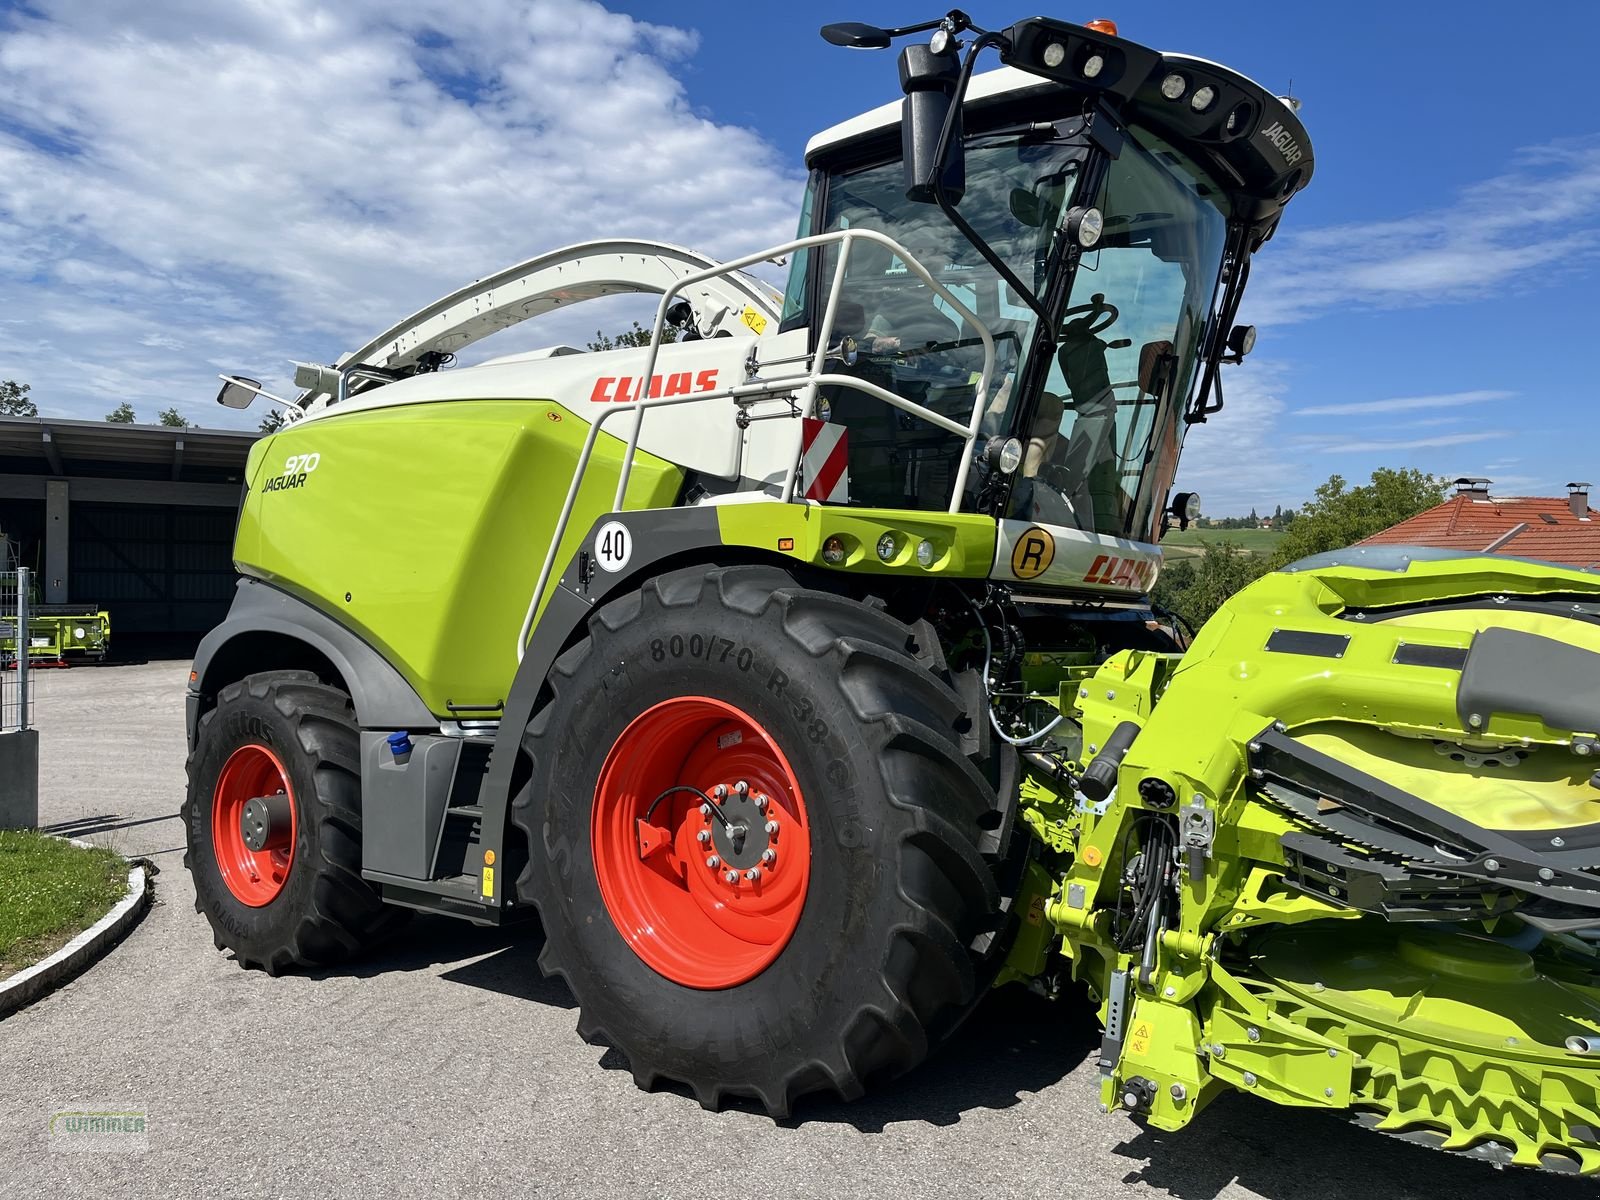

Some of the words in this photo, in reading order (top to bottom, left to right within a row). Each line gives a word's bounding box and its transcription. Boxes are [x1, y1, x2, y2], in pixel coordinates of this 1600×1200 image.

[1261, 121, 1302, 166] JAGUAR
[590, 369, 719, 402] CLAAS
[283, 452, 320, 476] 970
[261, 472, 307, 493] JAGUAR
[601, 530, 625, 561] 40
[1019, 537, 1046, 570] R
[650, 633, 754, 672] 800/70
[766, 666, 790, 698] R
[793, 697, 829, 744] 38
